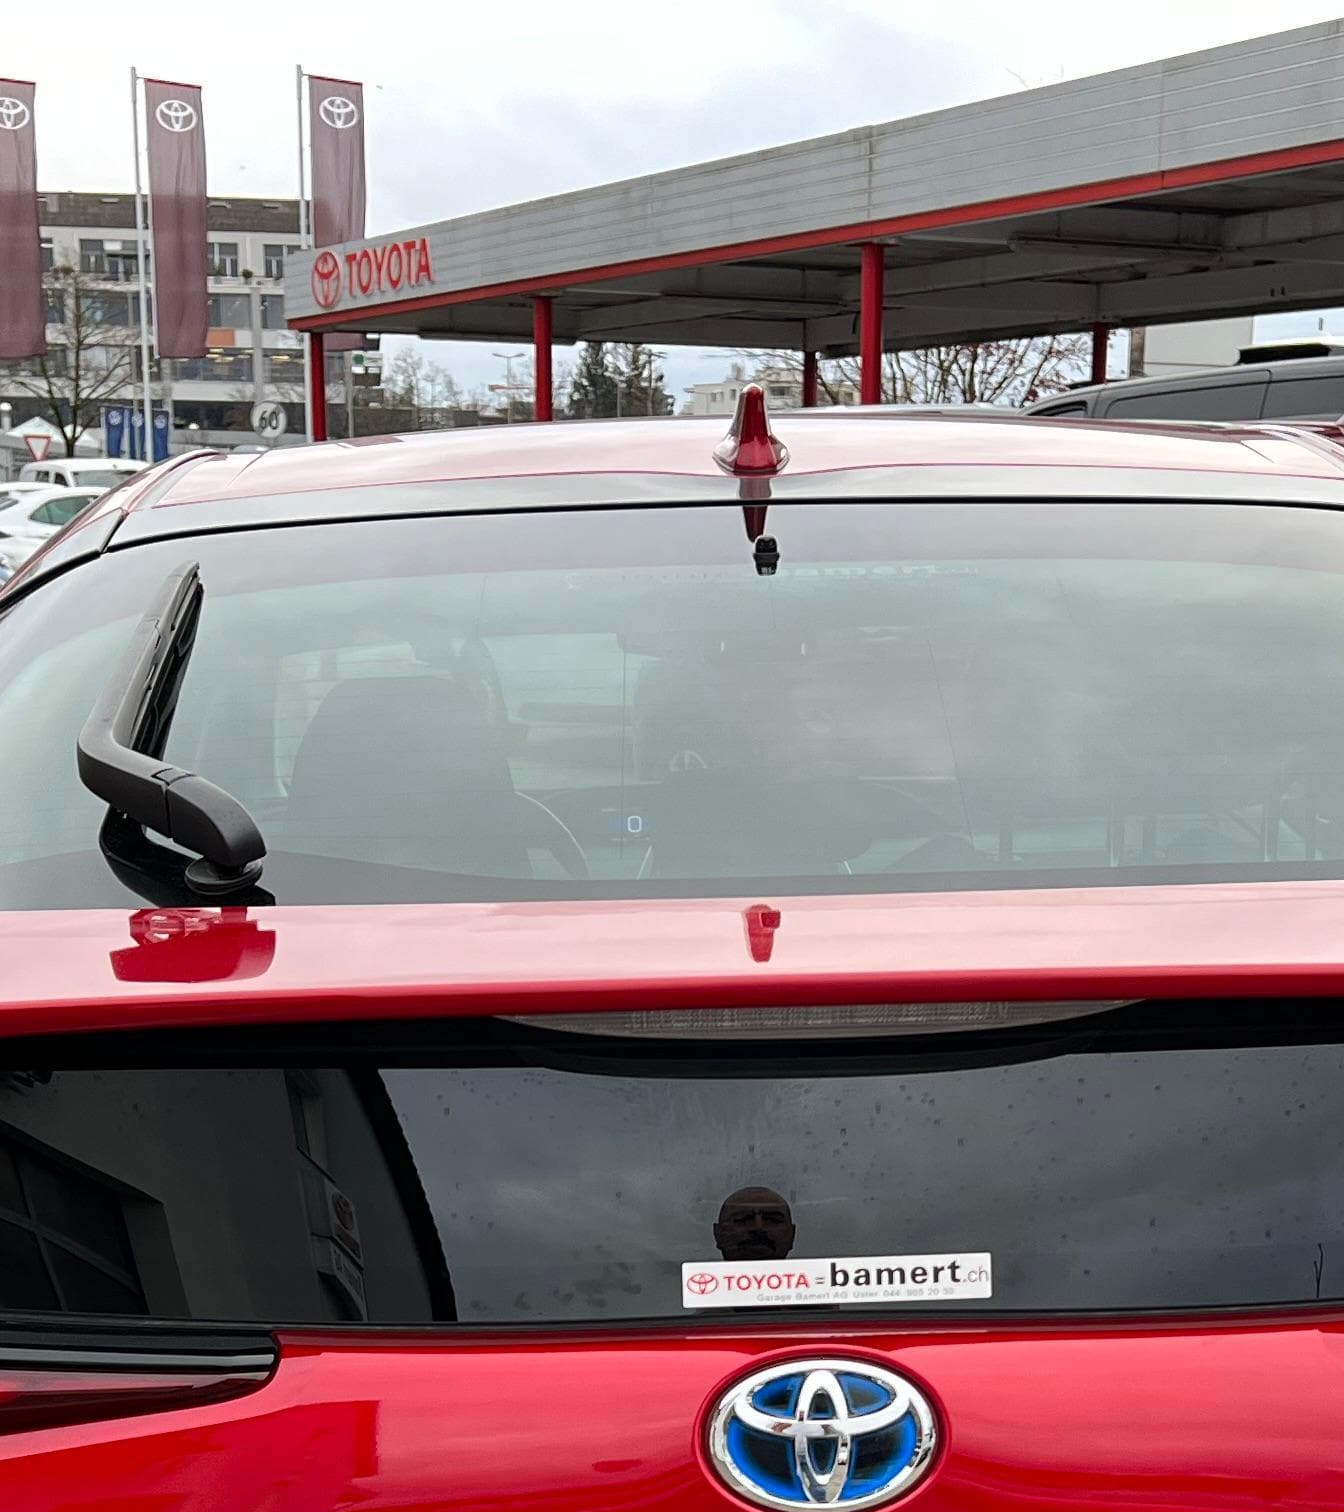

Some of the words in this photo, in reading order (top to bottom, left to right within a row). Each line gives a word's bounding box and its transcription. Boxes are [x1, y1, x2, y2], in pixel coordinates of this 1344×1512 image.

[345, 237, 433, 297] TOYOTA
[258, 409, 279, 430] 60
[723, 1273, 810, 1291] TOYOTA
[830, 1259, 990, 1288] bamert.ch
[795, 1291, 830, 1301] Bamert
[832, 1290, 848, 1300] AG
